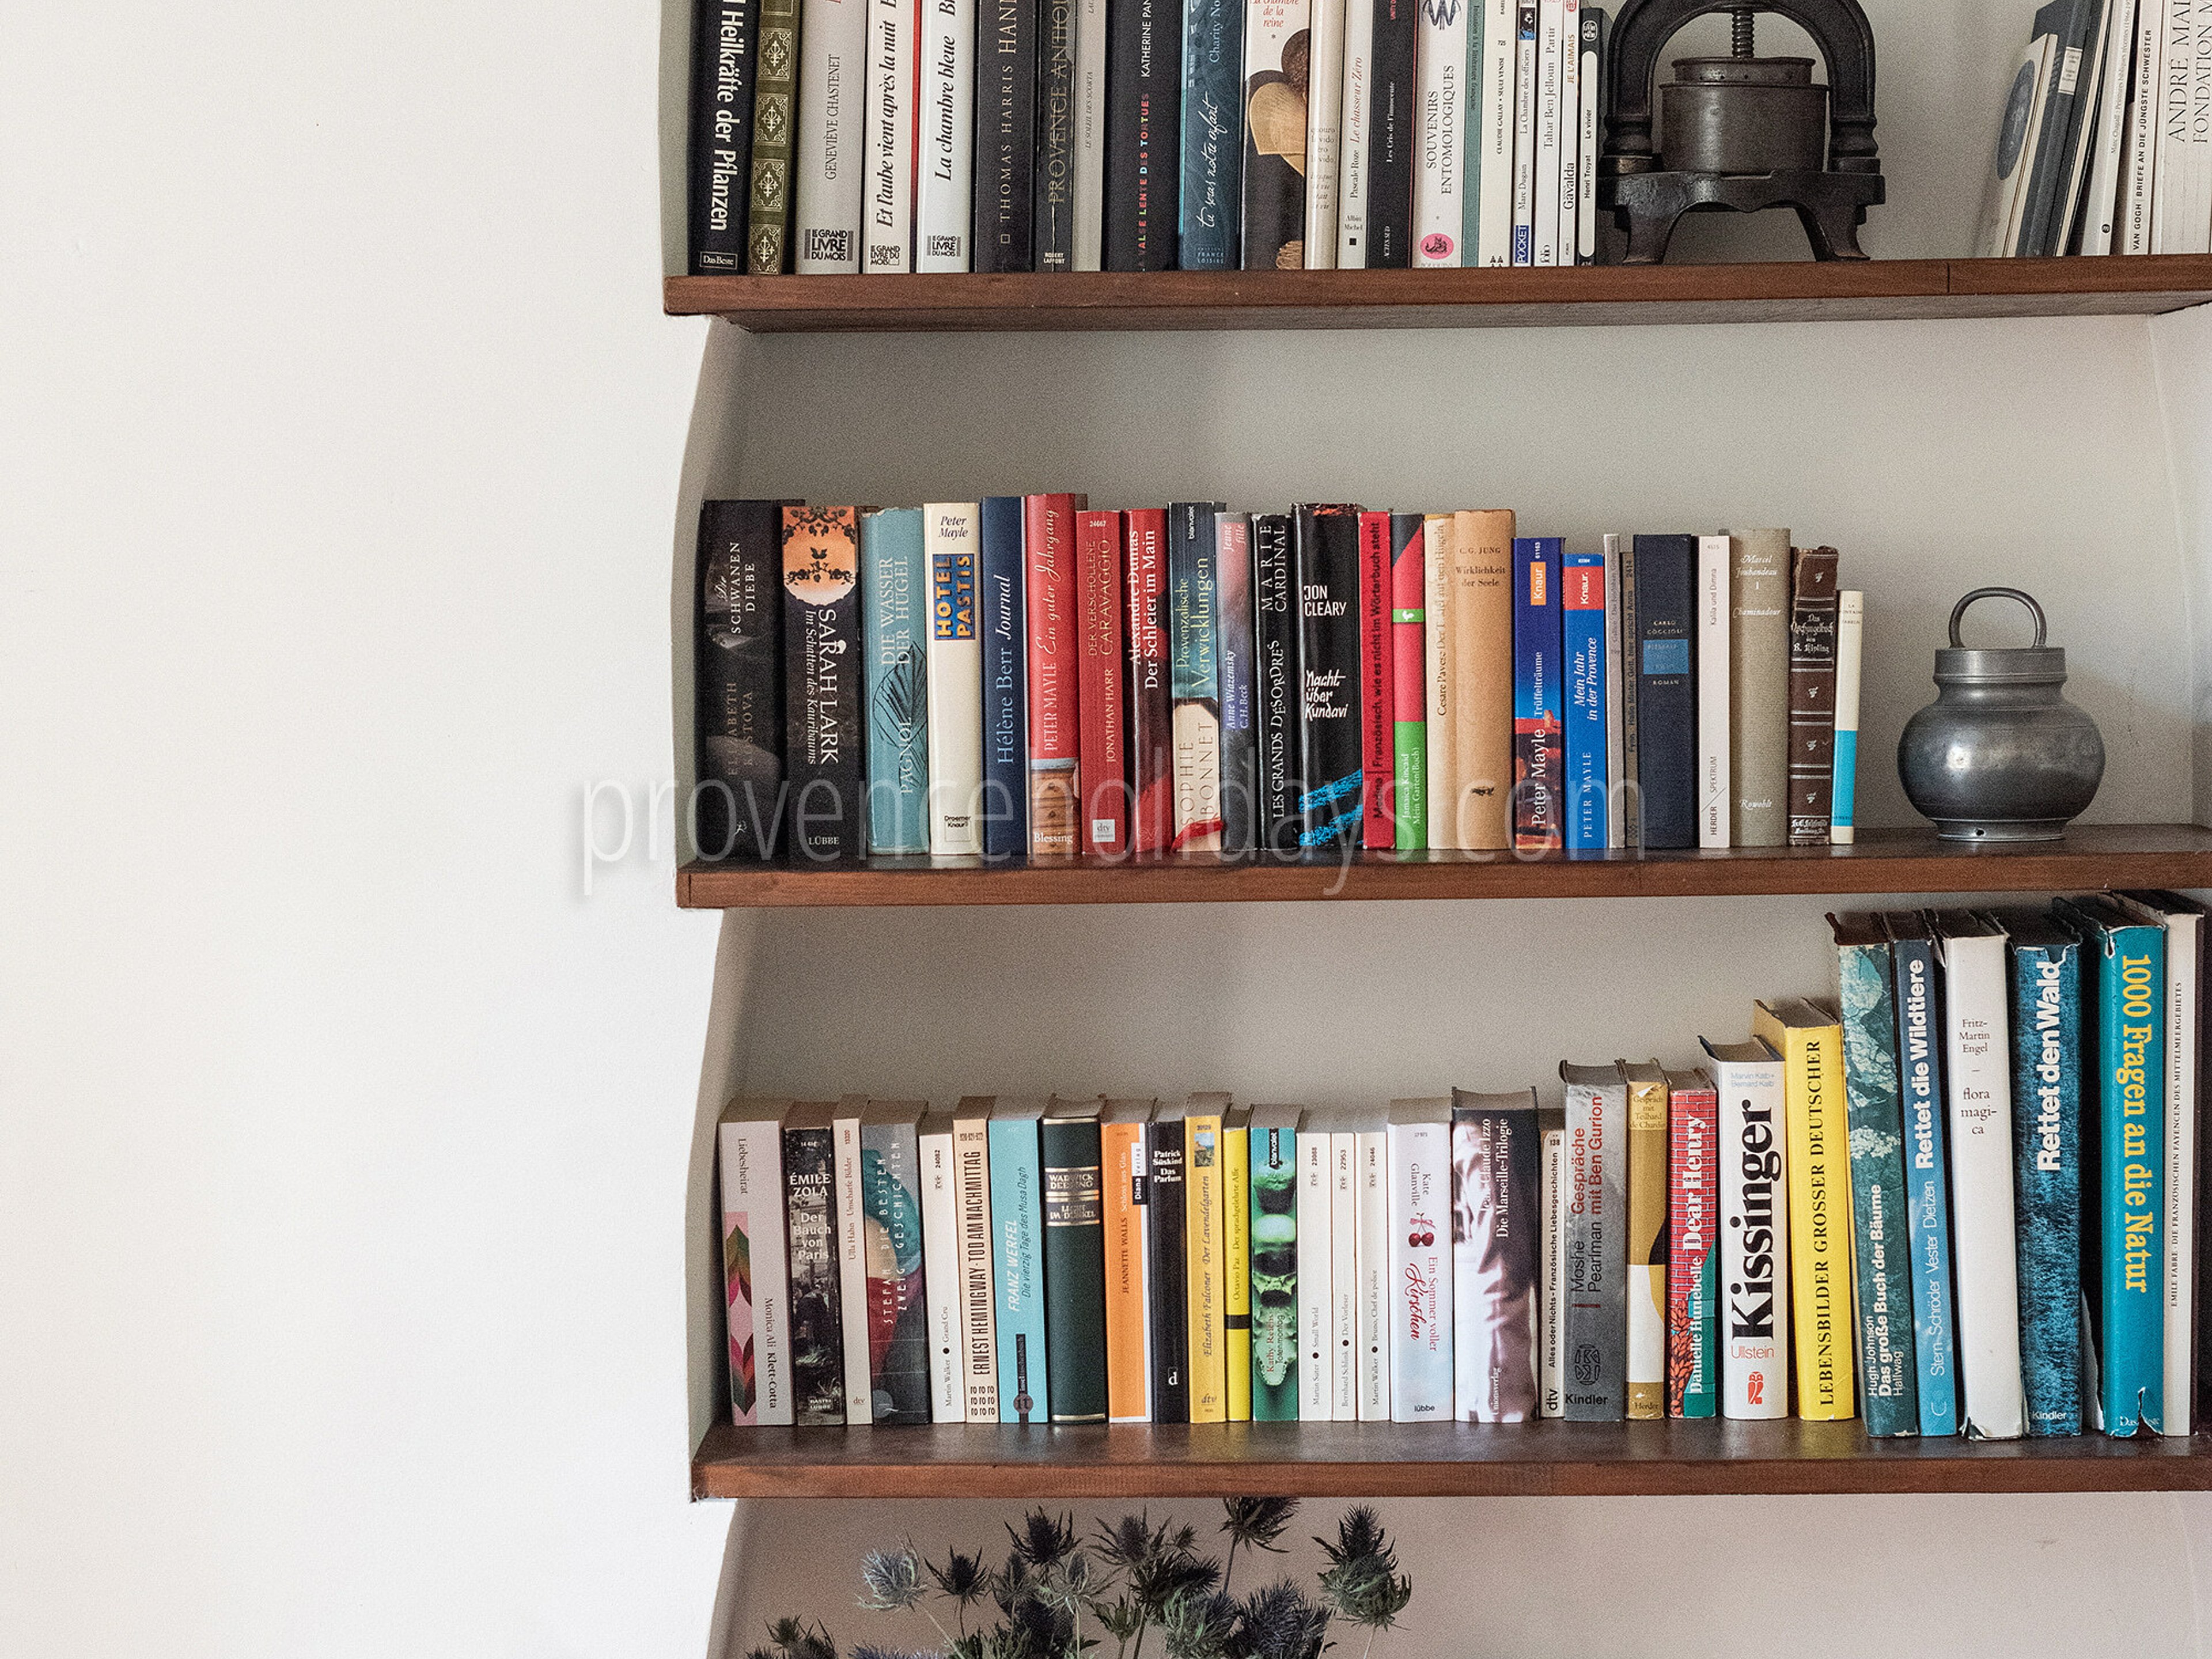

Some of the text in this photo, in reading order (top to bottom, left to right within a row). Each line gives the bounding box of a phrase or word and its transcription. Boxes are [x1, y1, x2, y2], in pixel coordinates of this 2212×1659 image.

[710, 10, 744, 230] Heilkräfte der Pflanzen
[825, 54, 841, 180] GENEVIÈVE CHASTENET
[876, 21, 896, 228] Et l'aube vient après la nuit
[934, 36, 955, 181] La chambre bleue
[1544, 26, 1556, 149] Tahar Ben Jelloun Partir
[2138, 150, 2144, 163] AN
[2142, 30, 2151, 85] SCHWESTER
[2168, 58, 2188, 142] ANDRÉ
[2194, 24, 2212, 143] FONDATION
[1001, 65, 1012, 222] THOMAS HARRIS
[1426, 90, 1438, 169] SOUVENIRS
[1441, 66, 1454, 194] ENTOMOLOGIQUES
[1564, 163, 1574, 210] Gavalda
[938, 527, 968, 539] Mayle
[940, 516, 966, 527] Peter
[730, 542, 741, 634] SCHWANEN
[746, 562, 755, 612] DIEBE
[937, 558, 952, 637] HOTEL
[957, 556, 972, 638] PASTIS
[1101, 539, 1112, 656] CARAVAGGIO
[1263, 525, 1273, 611] MARIE
[1274, 526, 1286, 611] CARDINAL
[1304, 585, 1327, 600] JON
[1304, 601, 1346, 617] CLEARY
[1533, 567, 1544, 599] Knaur
[1580, 571, 1589, 605] Knaur.
[879, 557, 895, 664] DIE WASSER
[895, 556, 910, 664] DER HÜGEL
[1035, 510, 1062, 751] PETER MAYLE Ein guter Jahrgang
[1143, 531, 1158, 689] Der Schleier im Main
[1176, 578, 1189, 668] Provenzalische
[1191, 558, 1214, 687] Verwicklungen
[819, 608, 839, 764] SARAH LARK
[995, 575, 1013, 763] Hélène Berr Journal
[1305, 669, 1346, 690] Nacht
[1306, 687, 1333, 703] über
[1533, 652, 1543, 717] Trüffelträume
[1575, 652, 1585, 707] Mein Jahr
[1587, 637, 1596, 721] in der Provence
[1305, 703, 1348, 720] Kundavi
[1531, 729, 1548, 826] Peter Mayle
[1583, 752, 1592, 838] PETER MAYLE
[808, 836, 839, 845] LÜBBE
[1034, 832, 1073, 843] Blessing
[1908, 960, 1934, 1169] Rettet die Wildtiere
[1960, 1032, 1990, 1041] Martin
[1962, 1018, 1988, 1029] Fritz-
[1963, 1044, 1988, 1055] Engel
[1963, 1088, 1990, 1100] flora
[2036, 961, 2062, 1172] Rettet den Wald
[1961, 1105, 1998, 1120] magi-
[1972, 1125, 1985, 1135] ca
[2117, 954, 2154, 1293] 1000 Fragen an die Natur
[790, 1173, 831, 1184] ÉMILE
[794, 1187, 827, 1197] ZOLA
[1154, 1175, 1181, 1183] Parfum
[1571, 1128, 1586, 1214] Gespräche
[1588, 1097, 1602, 1215] mit Ben Gurion
[1683, 1116, 1707, 1251] Dear Henry
[794, 1224, 831, 1234] Bauch
[798, 1250, 828, 1260] Paris
[801, 1213, 823, 1223] Der
[802, 1237, 823, 1247] von
[1588, 1222, 1602, 1293] Pearlman
[1730, 1100, 1781, 1339] Kissinger
[1807, 1040, 1834, 1406] LEBENSBILDER GROSSER DEUTSCHER
[964, 1151, 990, 1374] ERNEST HEMINGWAY TOD AM NACHMITTAG
[1005, 1219, 1020, 1312] FRANZ WERFEL
[1405, 1263, 1427, 1340] Kirschen
[1571, 1241, 1585, 1292] Moshe
[1870, 1185, 1893, 1397] Das große Buch der Bäume
[1923, 1181, 1945, 1376] Stern Schröder Vester Dietzen
[1730, 1345, 1775, 1359] Ullstein
[1414, 1404, 1435, 1412] lübbe
[1565, 1393, 1608, 1406] Kindler
[2033, 1410, 2067, 1421] Kindler
